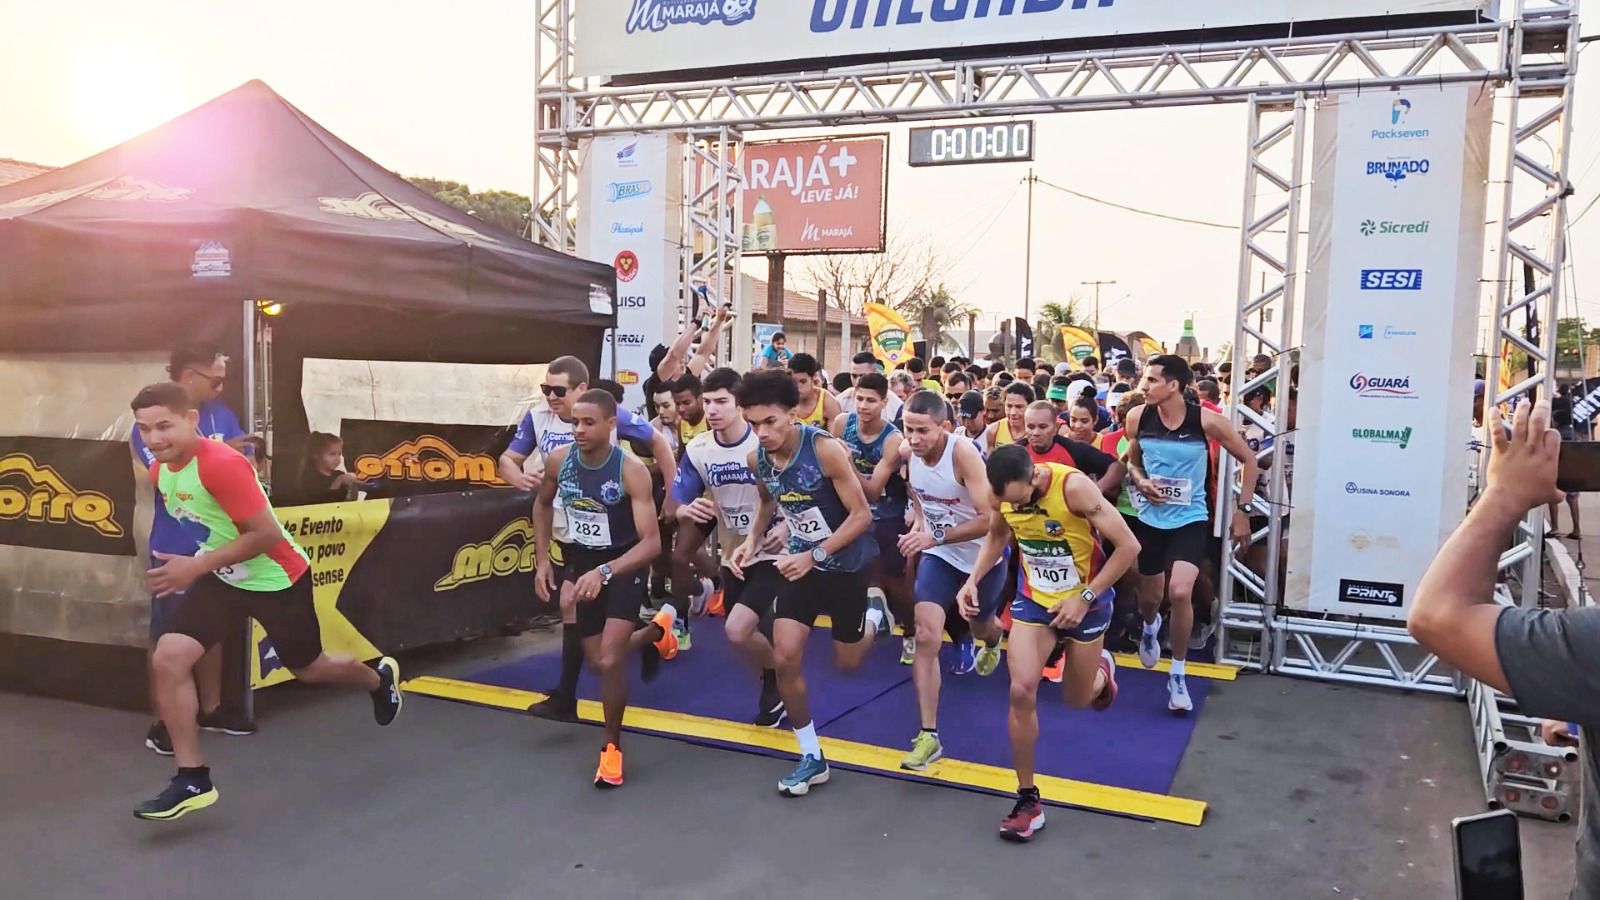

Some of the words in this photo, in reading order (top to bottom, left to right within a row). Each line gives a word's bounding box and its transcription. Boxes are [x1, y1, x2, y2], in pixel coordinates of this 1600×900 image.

[931, 124, 1029, 160] 0:00:00
[1372, 129, 1430, 139] Packseven
[1366, 159, 1430, 175] BRUNADO
[801, 188, 833, 203] LEVE
[834, 183, 859, 200] JÁ!
[821, 226, 853, 237] MARAJÁ
[1379, 220, 1430, 234] Sicredi
[1366, 271, 1417, 288] SESI
[1368, 375, 1410, 389] GUARÁ
[711, 463, 740, 473] Corrida
[1379, 489, 1411, 497] SONORA
[301, 516, 343, 536] Evento
[574, 521, 602, 537] 282
[318, 542, 345, 564] povo
[1034, 566, 1068, 583] 1407
[1347, 587, 1394, 598] PRINT
